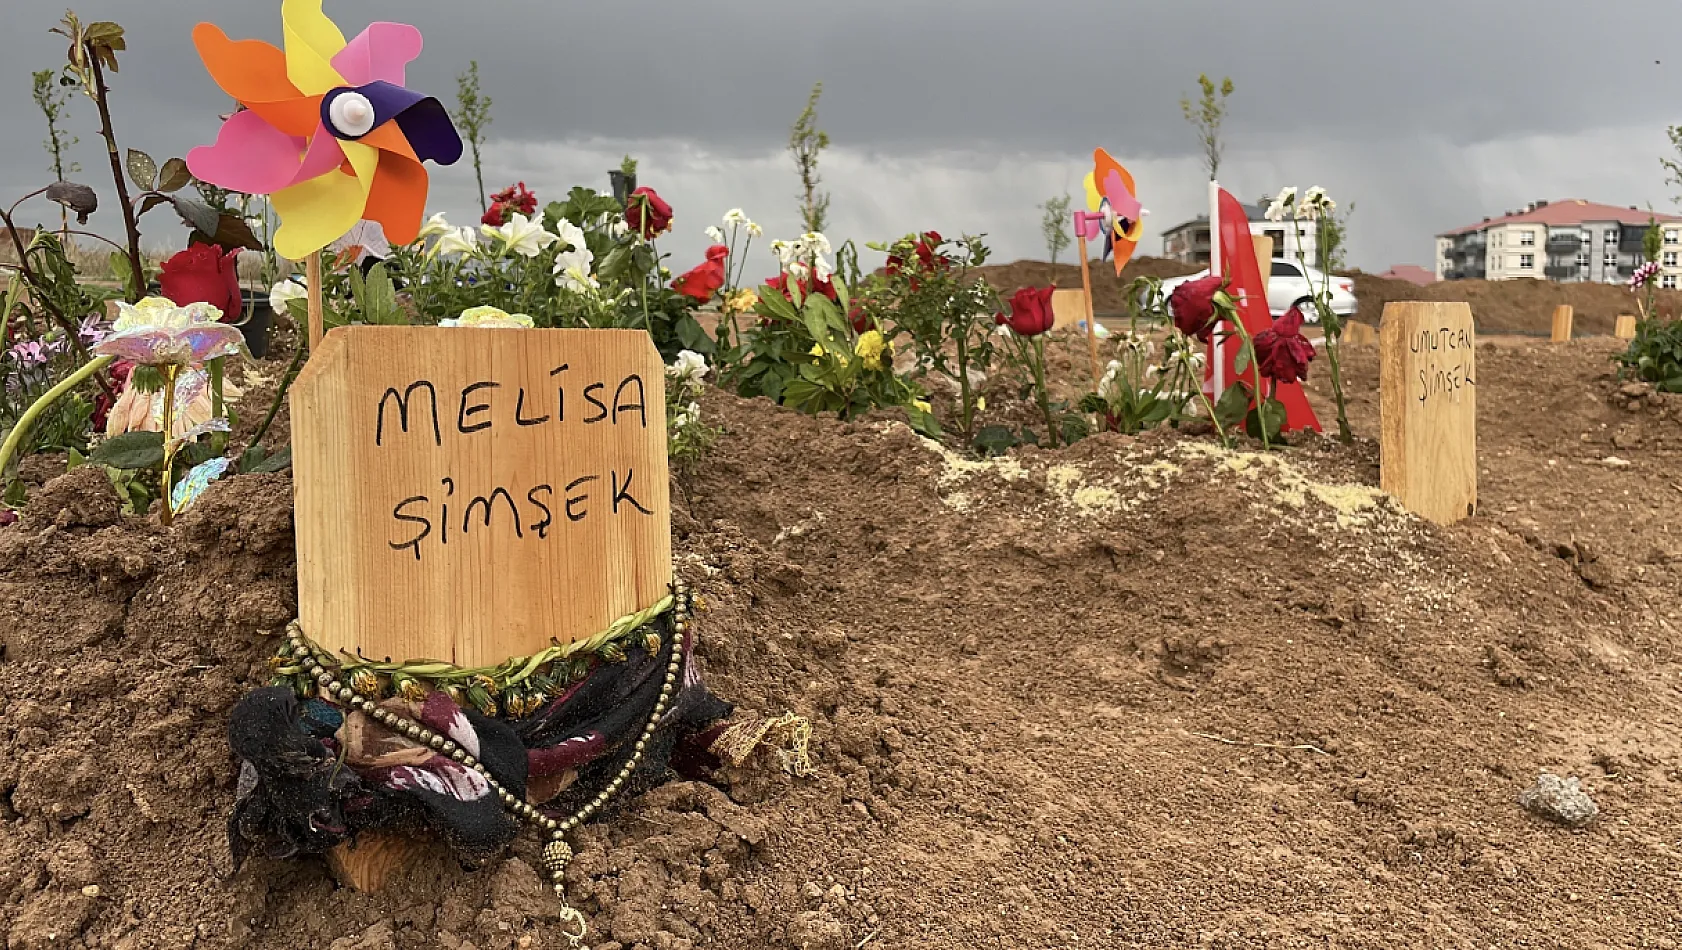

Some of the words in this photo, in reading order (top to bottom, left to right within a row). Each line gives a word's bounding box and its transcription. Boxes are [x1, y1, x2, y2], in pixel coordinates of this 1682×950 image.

[1410, 327, 1471, 353] UMUTCAN
[376, 363, 647, 447] MELİSA
[389, 468, 655, 560] ŞİMŞEK
